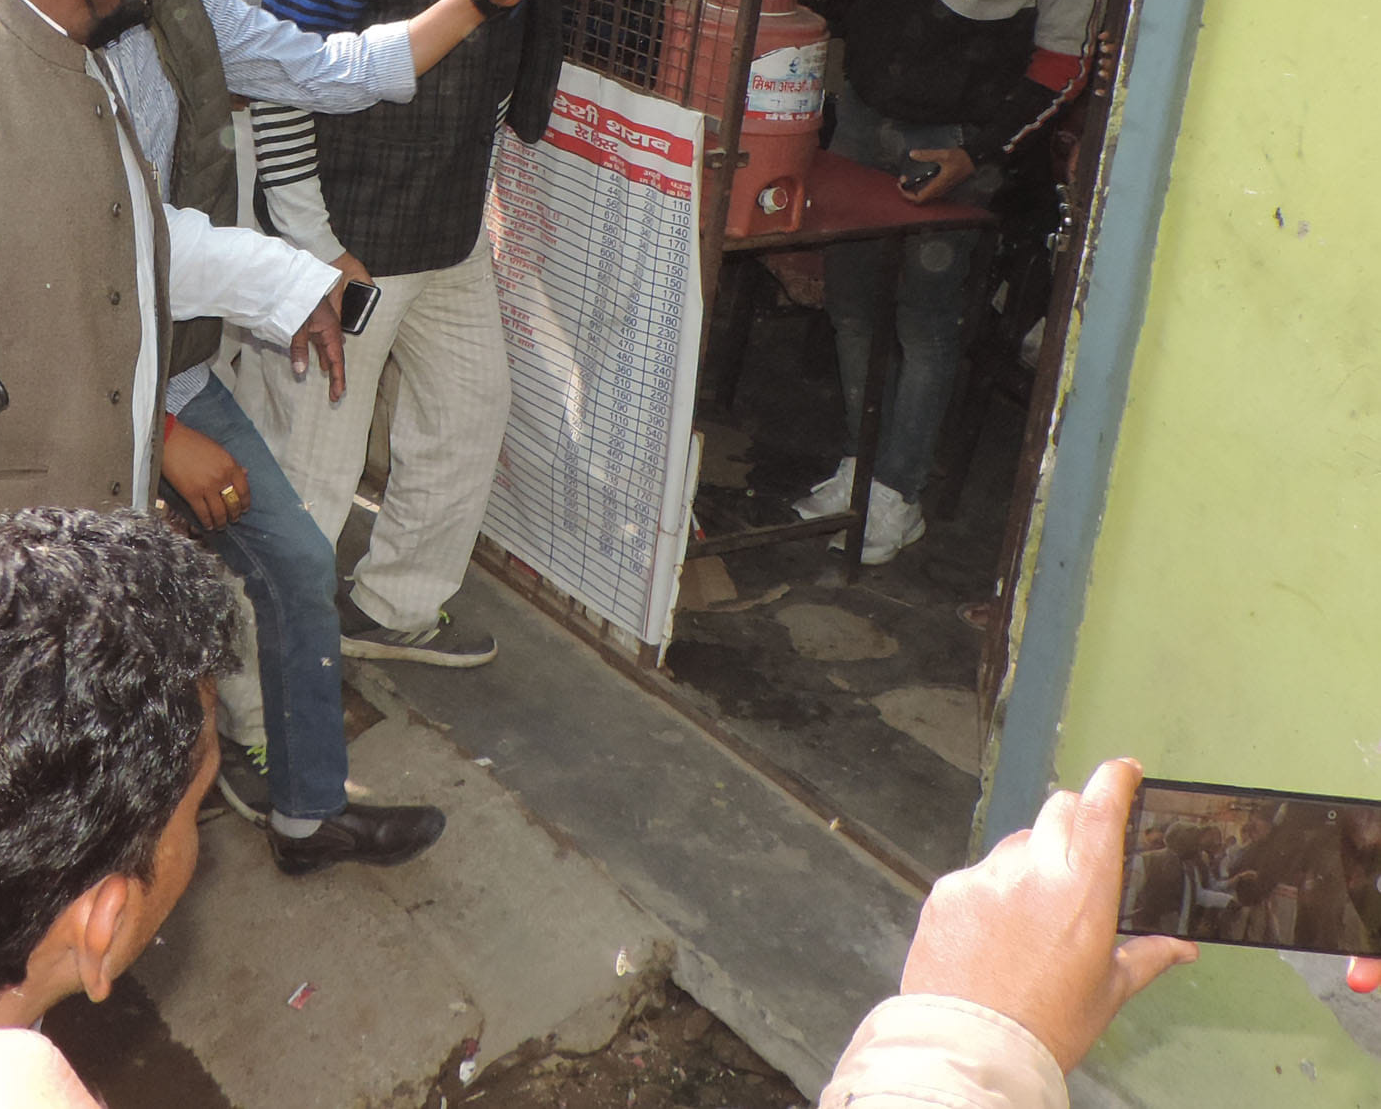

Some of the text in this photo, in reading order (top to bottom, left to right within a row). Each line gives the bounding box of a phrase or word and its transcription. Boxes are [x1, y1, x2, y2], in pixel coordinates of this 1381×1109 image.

[606, 119, 671, 155] शराब
[673, 200, 691, 212] 110
[672, 214, 689, 226] 110
[670, 226, 688, 238] 140
[669, 239, 686, 251] 170
[667, 251, 685, 264] 170
[666, 264, 683, 277] 150
[664, 277, 682, 290] 150
[663, 290, 680, 302] 170
[661, 302, 679, 315] 170
[660, 315, 678, 327] 180
[658, 327, 676, 339] 230
[619, 339, 634, 352] 470
[654, 352, 673, 365] 230
[656, 340, 674, 353] 210
[653, 364, 671, 377] 240
[650, 390, 668, 403] 250
[647, 415, 664, 428] 390
[645, 427, 663, 440] 540
